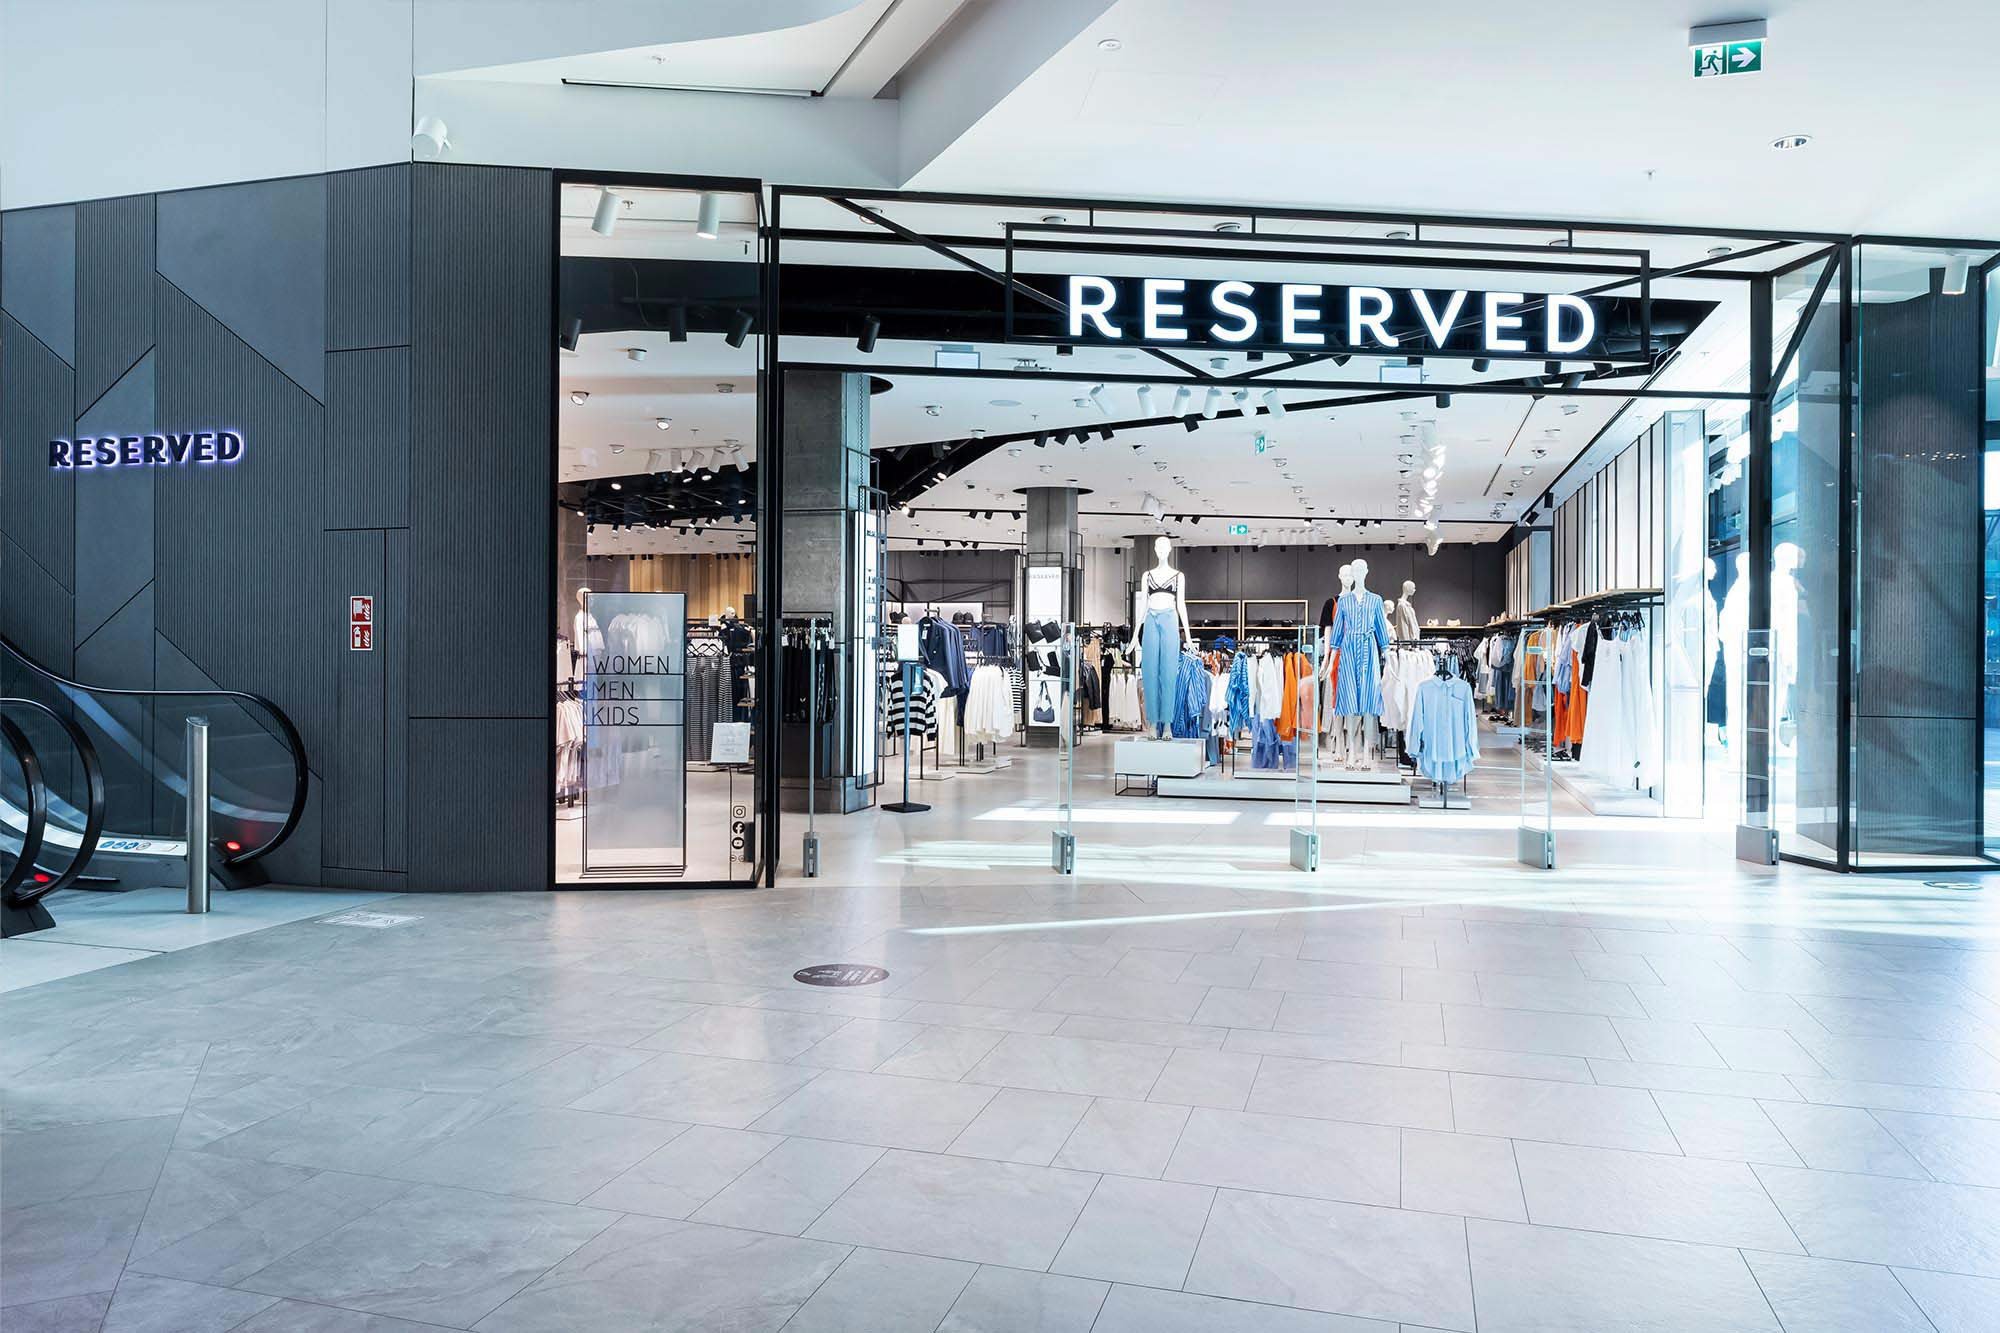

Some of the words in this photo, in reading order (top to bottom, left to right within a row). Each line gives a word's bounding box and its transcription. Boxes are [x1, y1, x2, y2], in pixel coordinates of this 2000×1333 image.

[1069, 275, 1596, 354] RESERVED
[49, 432, 241, 467] RESERVED
[593, 655, 669, 674] WOMEN
[592, 681, 634, 699] MEN
[592, 706, 640, 725] KIDS
